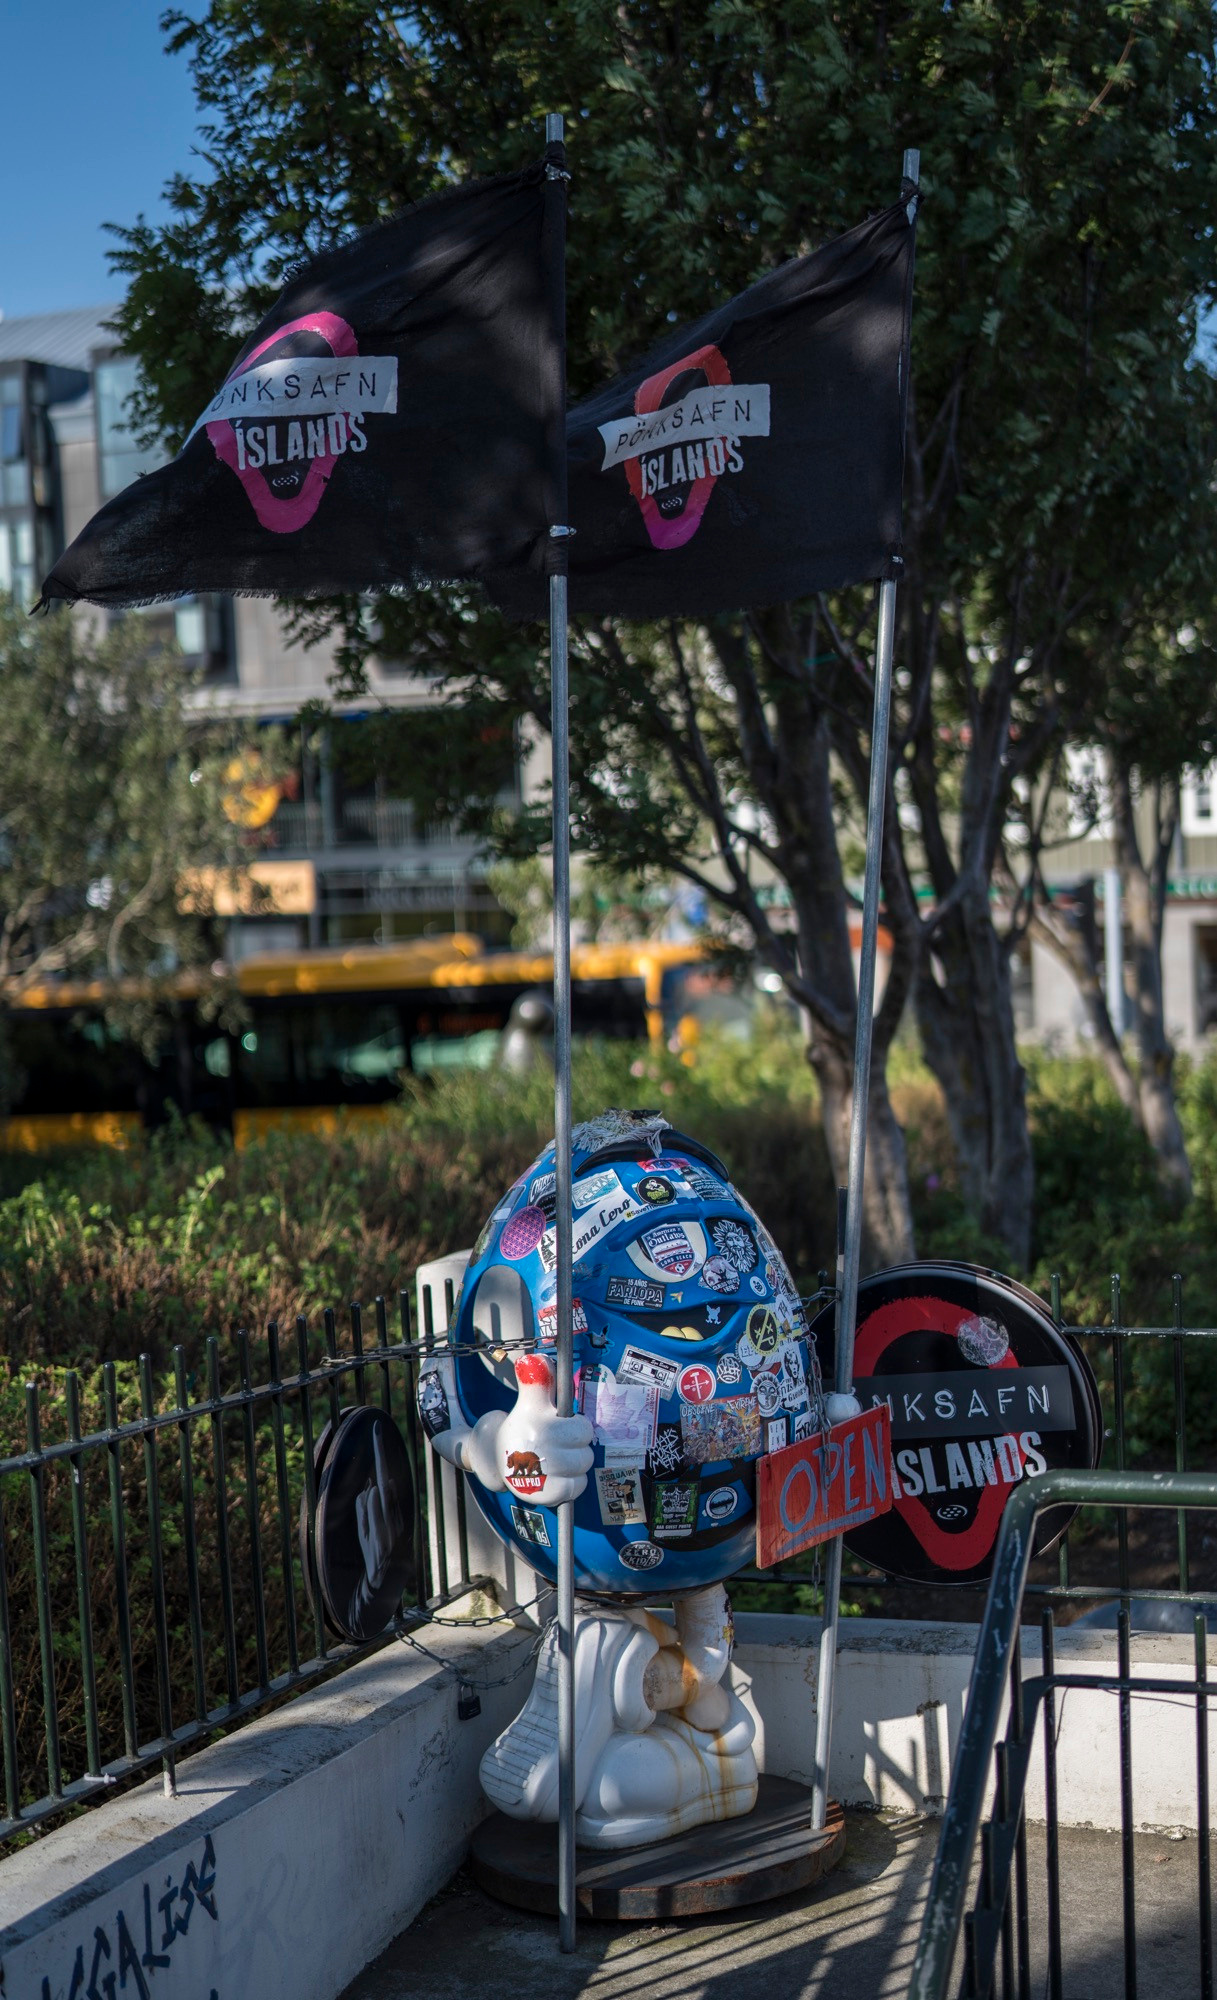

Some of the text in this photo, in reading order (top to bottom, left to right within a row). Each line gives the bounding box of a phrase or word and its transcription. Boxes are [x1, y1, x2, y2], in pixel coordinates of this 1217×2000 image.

[210, 372, 376, 413] ÖNKSAFN
[614, 399, 751, 454] PÖNKSAFN
[234, 412, 369, 471] ÍSLANDS
[640, 435, 745, 500] ÍSLANDS
[571, 1224, 601, 1255] ona
[648, 1232, 686, 1247] Outlaws
[675, 1253, 693, 1262] BEACH
[607, 1283, 663, 1303] FARLOPA
[681, 1403, 716, 1418] OBSCENE
[871, 1384, 1051, 1423] NKSAFN
[526, 1477, 541, 1488] PRO
[598, 1468, 638, 1482] DISQUAIRE
[779, 1420, 887, 1534] OPEN
[535, 1530, 548, 1545] 05
